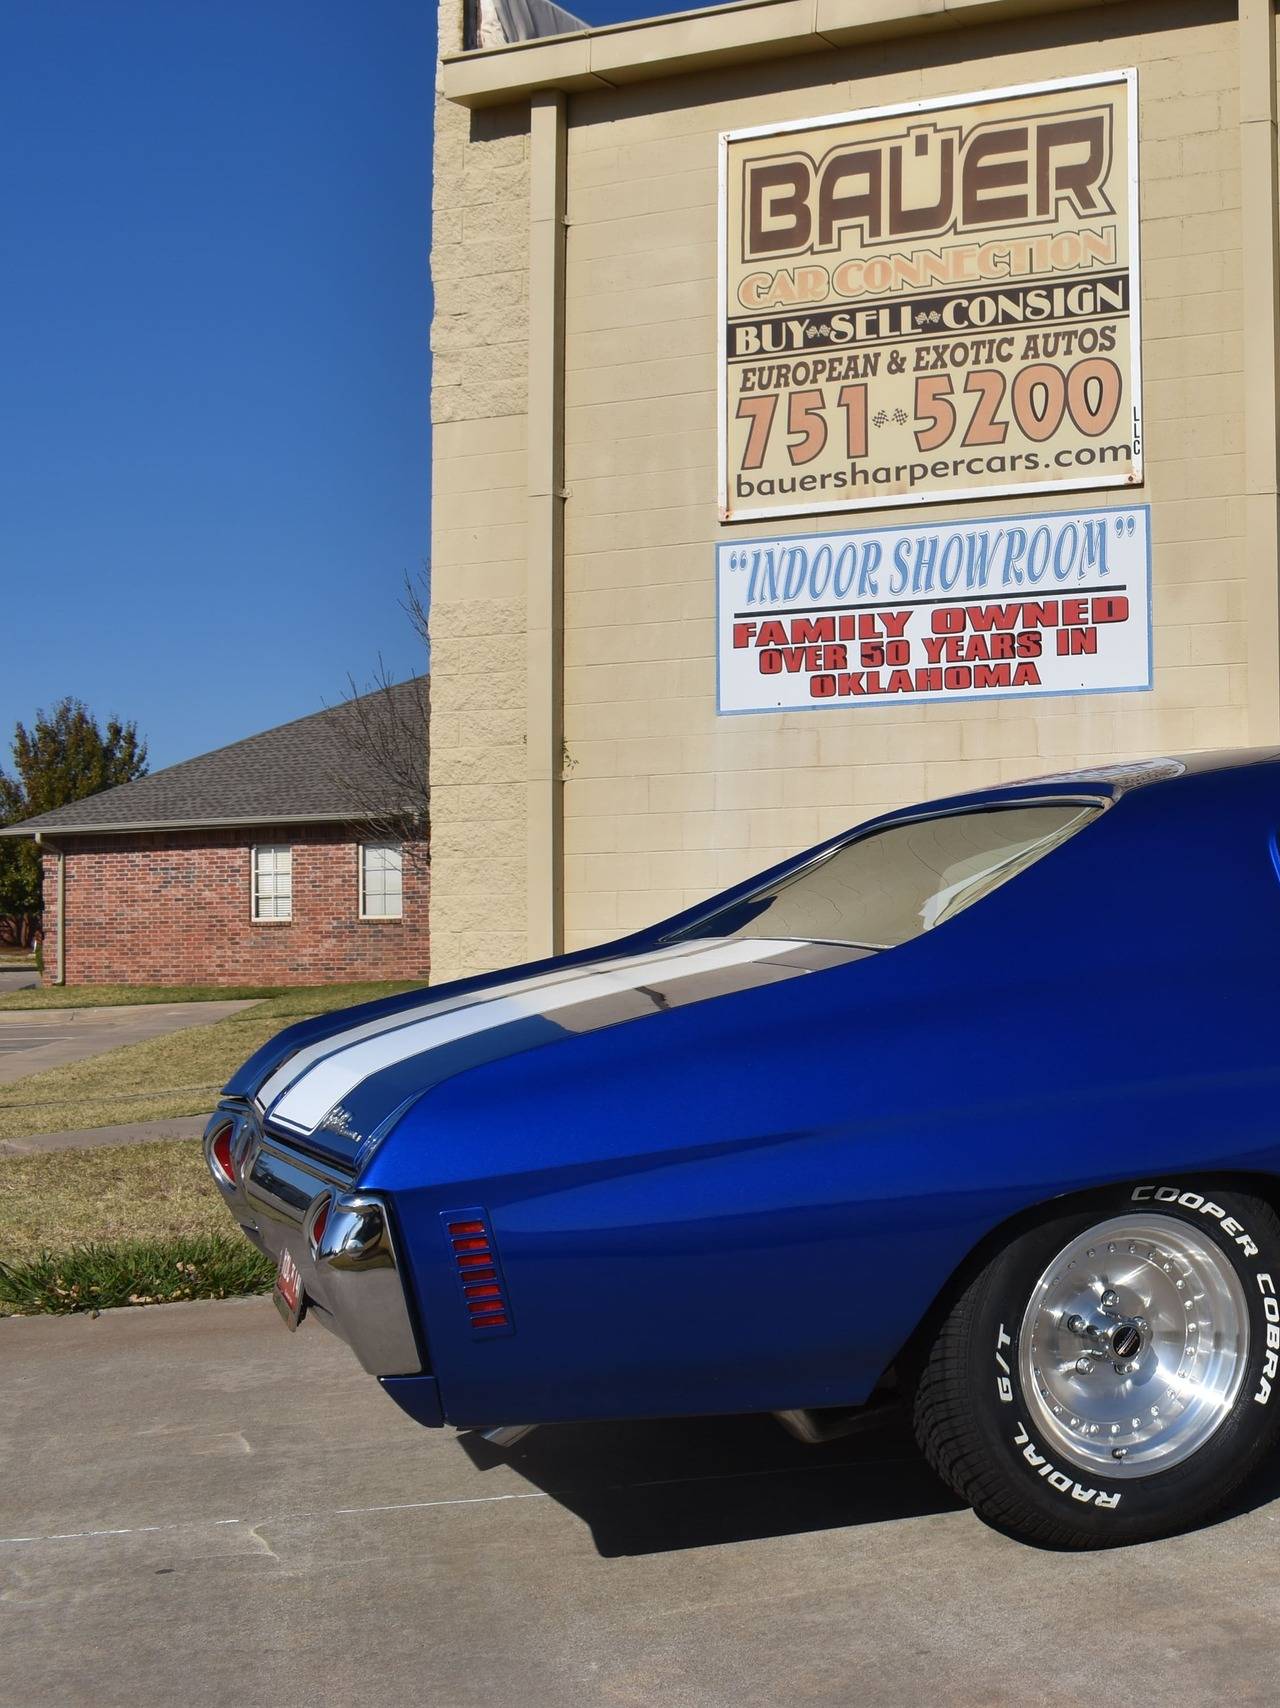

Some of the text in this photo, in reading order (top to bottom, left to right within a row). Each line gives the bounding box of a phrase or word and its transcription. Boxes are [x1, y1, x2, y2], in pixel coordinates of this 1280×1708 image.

[832, 225, 1116, 297] CONNECTION
[735, 280, 1123, 355] BUY SELL CONSIGN
[739, 325, 1117, 392] EUROPEAN & EXOTIC AUTOS
[735, 357, 1123, 470] 751 5200
[1133, 406, 1141, 455] LLC
[736, 444, 1132, 498] bauersharpercars.com
[733, 596, 1129, 649] FAMILY OWNED
[759, 626, 1098, 674] OVER 50 YEARS IN
[809, 661, 1042, 698] OKLAHOMA
[1130, 1184, 1259, 1258] COOPER
[995, 1323, 1123, 1510] RADIAL G/T
